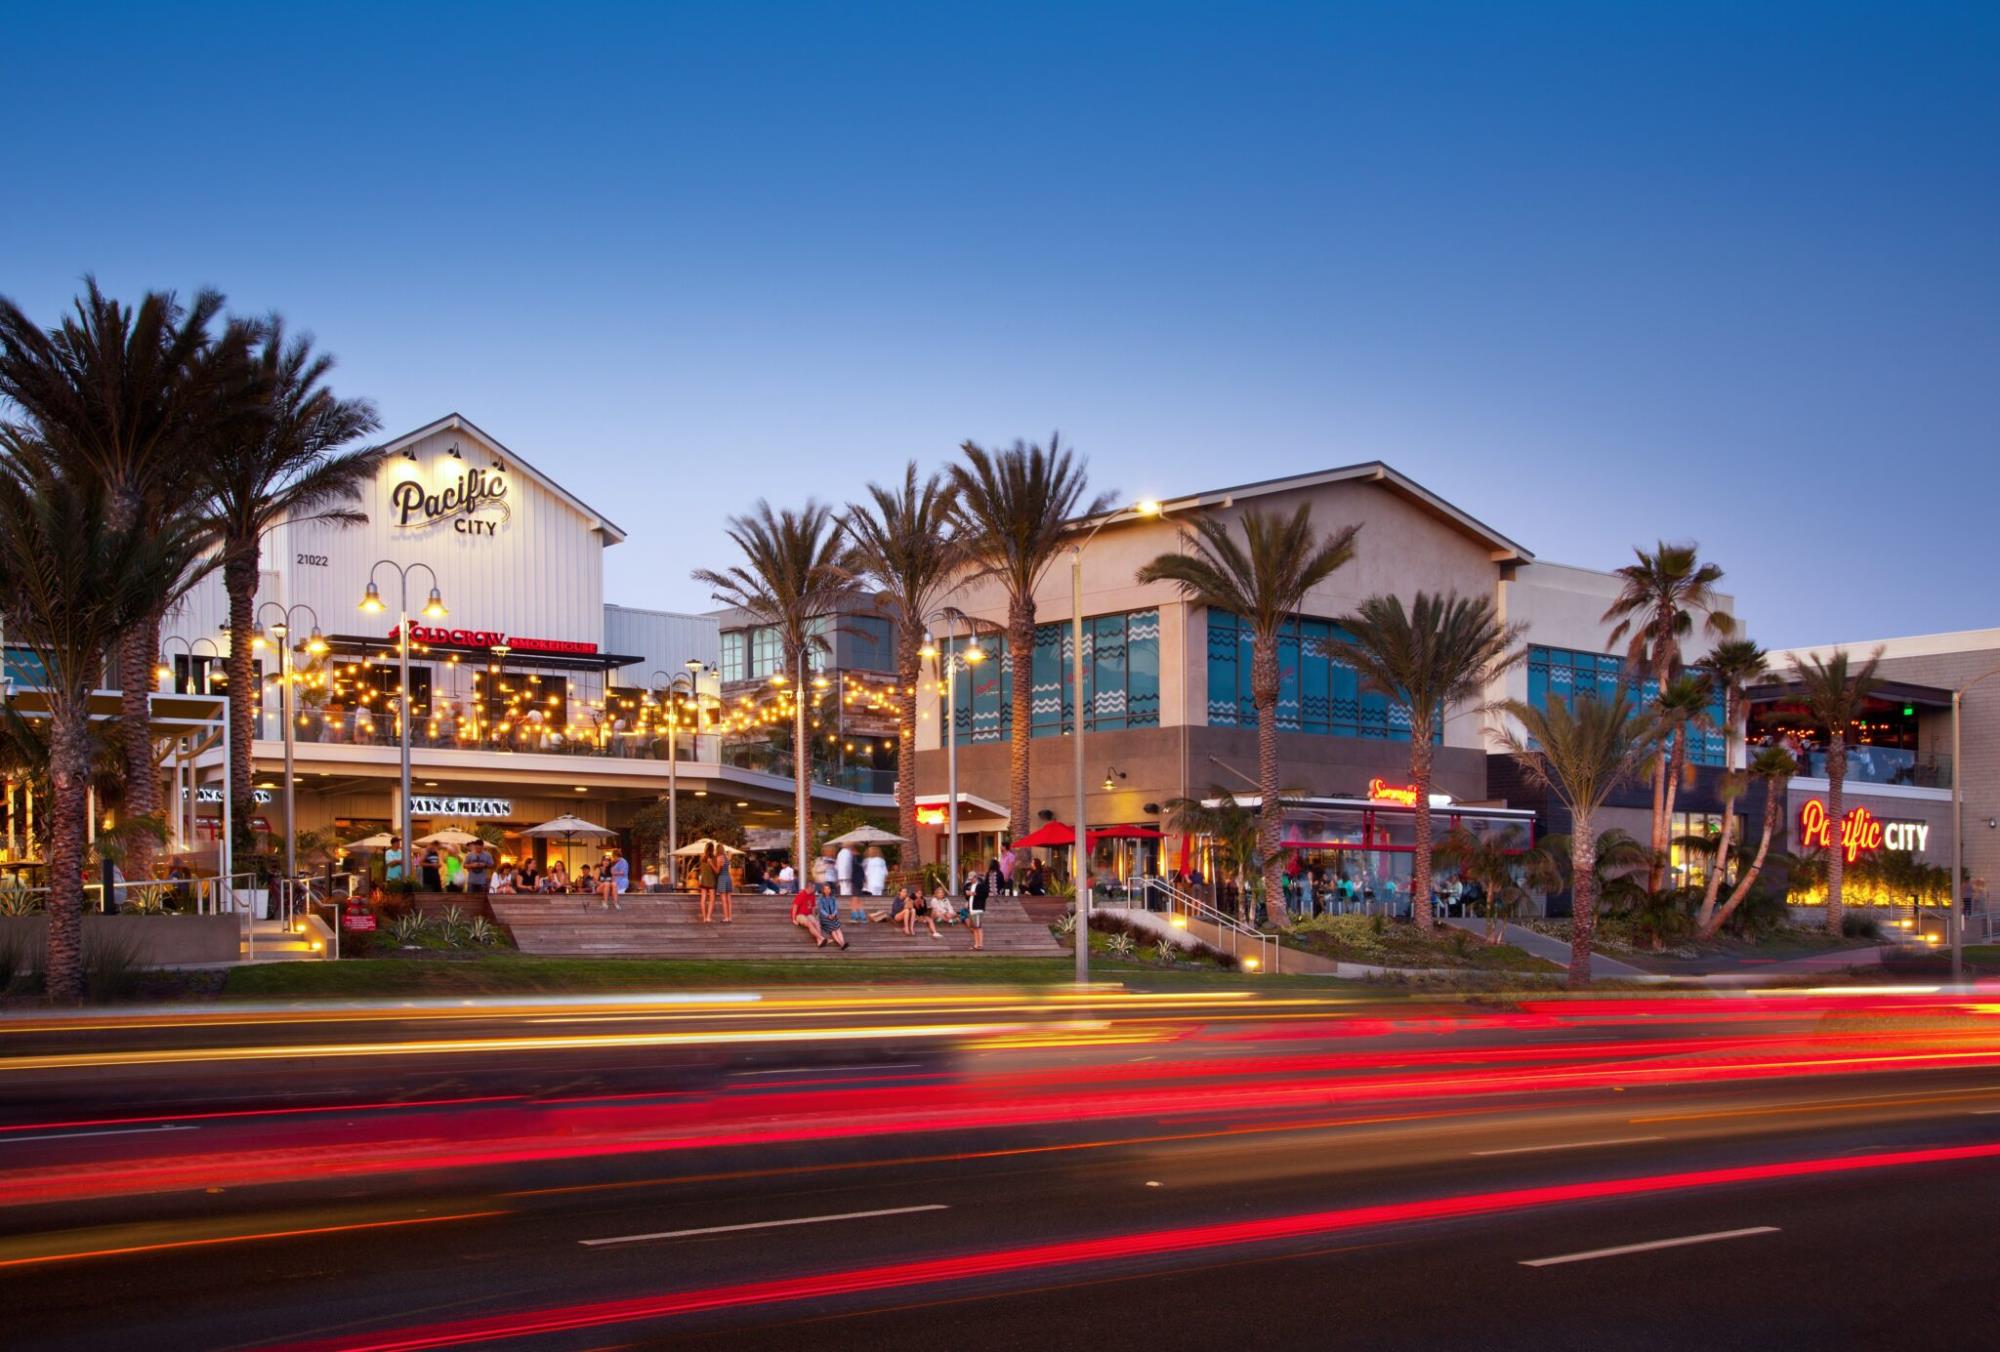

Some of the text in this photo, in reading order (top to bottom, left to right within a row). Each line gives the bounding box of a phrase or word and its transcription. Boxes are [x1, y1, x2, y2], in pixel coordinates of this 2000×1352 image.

[392, 468, 507, 525] Pacific
[454, 518, 497, 536] CITY
[296, 553, 328, 567] 21022
[411, 625, 597, 653] OLD CROW SMOKEHOUSE
[444, 800, 456, 813] &
[457, 800, 511, 815] MEANS
[1803, 799, 1929, 862] Paific CITY
